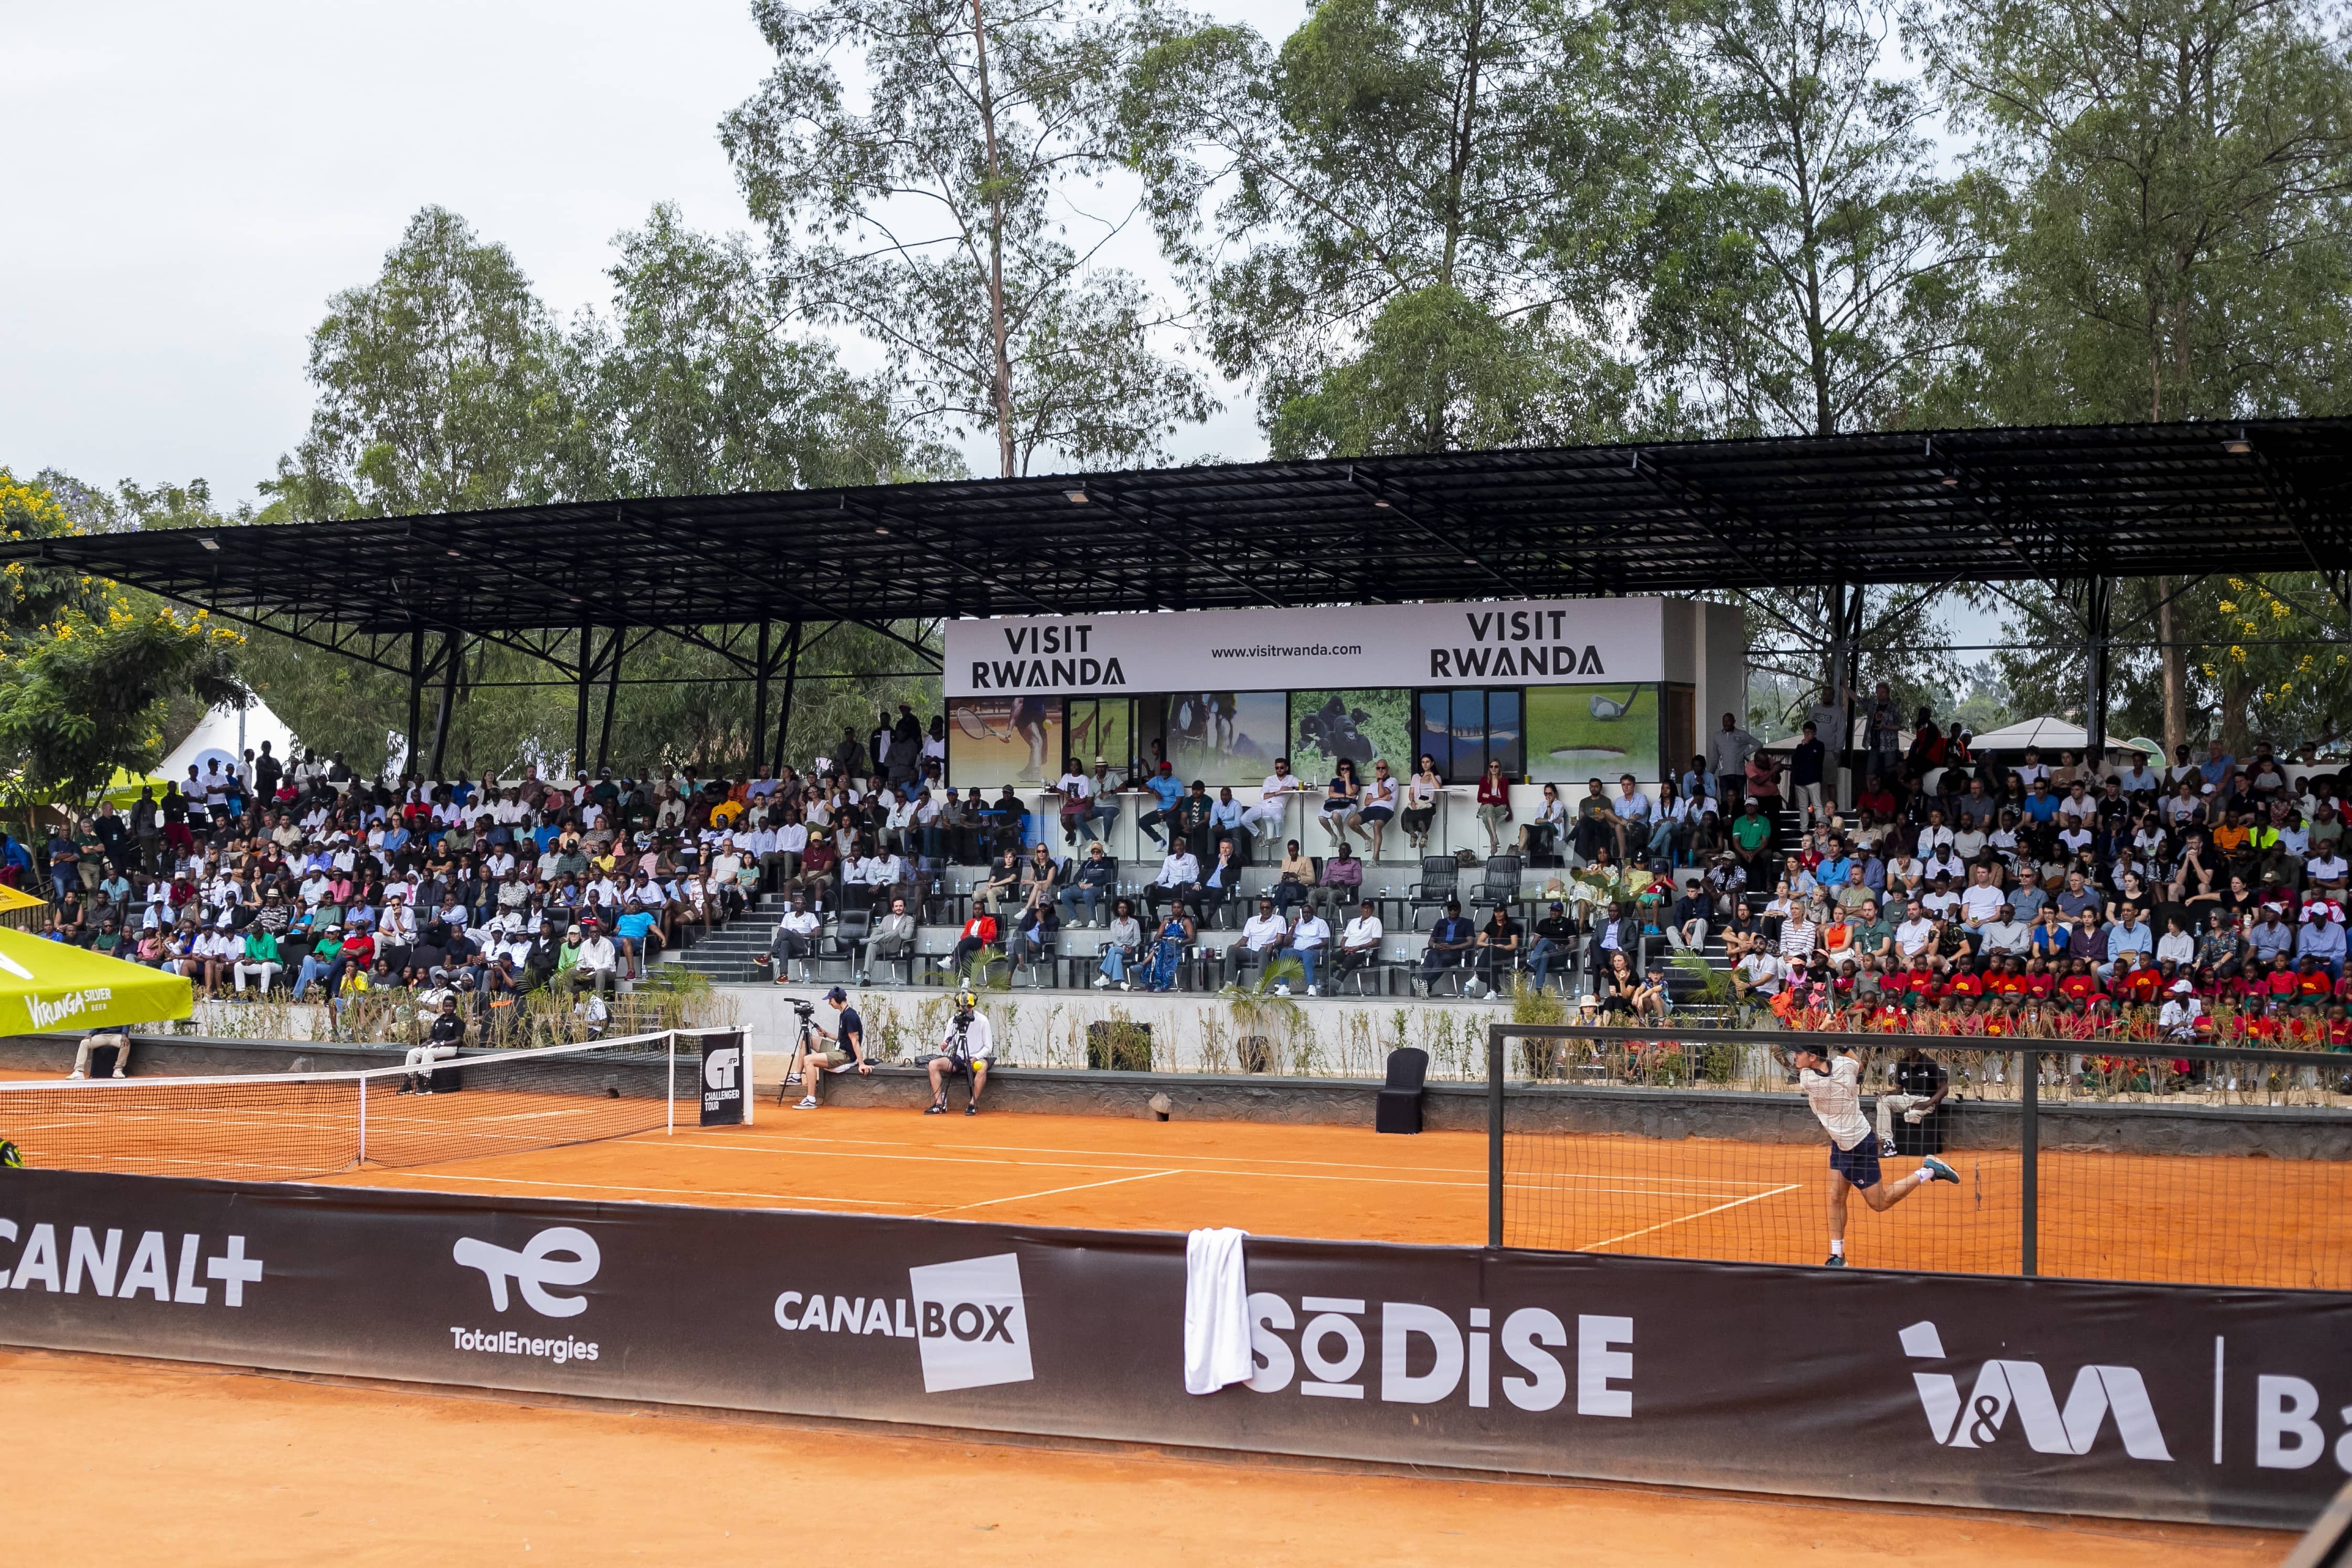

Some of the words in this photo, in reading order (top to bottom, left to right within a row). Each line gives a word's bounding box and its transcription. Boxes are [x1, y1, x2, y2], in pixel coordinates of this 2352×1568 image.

[1004, 624, 1092, 655] VISIT
[1466, 610, 1566, 642] VISIT
[1211, 643, 1361, 658] www.visitrwanda.com
[1430, 645, 1605, 678] RWANDA
[972, 657, 1126, 689] RWANDA
[24, 991, 86, 1029] VIRUNGA
[84, 988, 112, 1002] SILVER
[91, 1003, 107, 1011] BEER
[705, 1090, 740, 1101] CHALLENGER
[705, 1101, 719, 1112] TOUR
[450, 1327, 599, 1364] TotalEnergies
